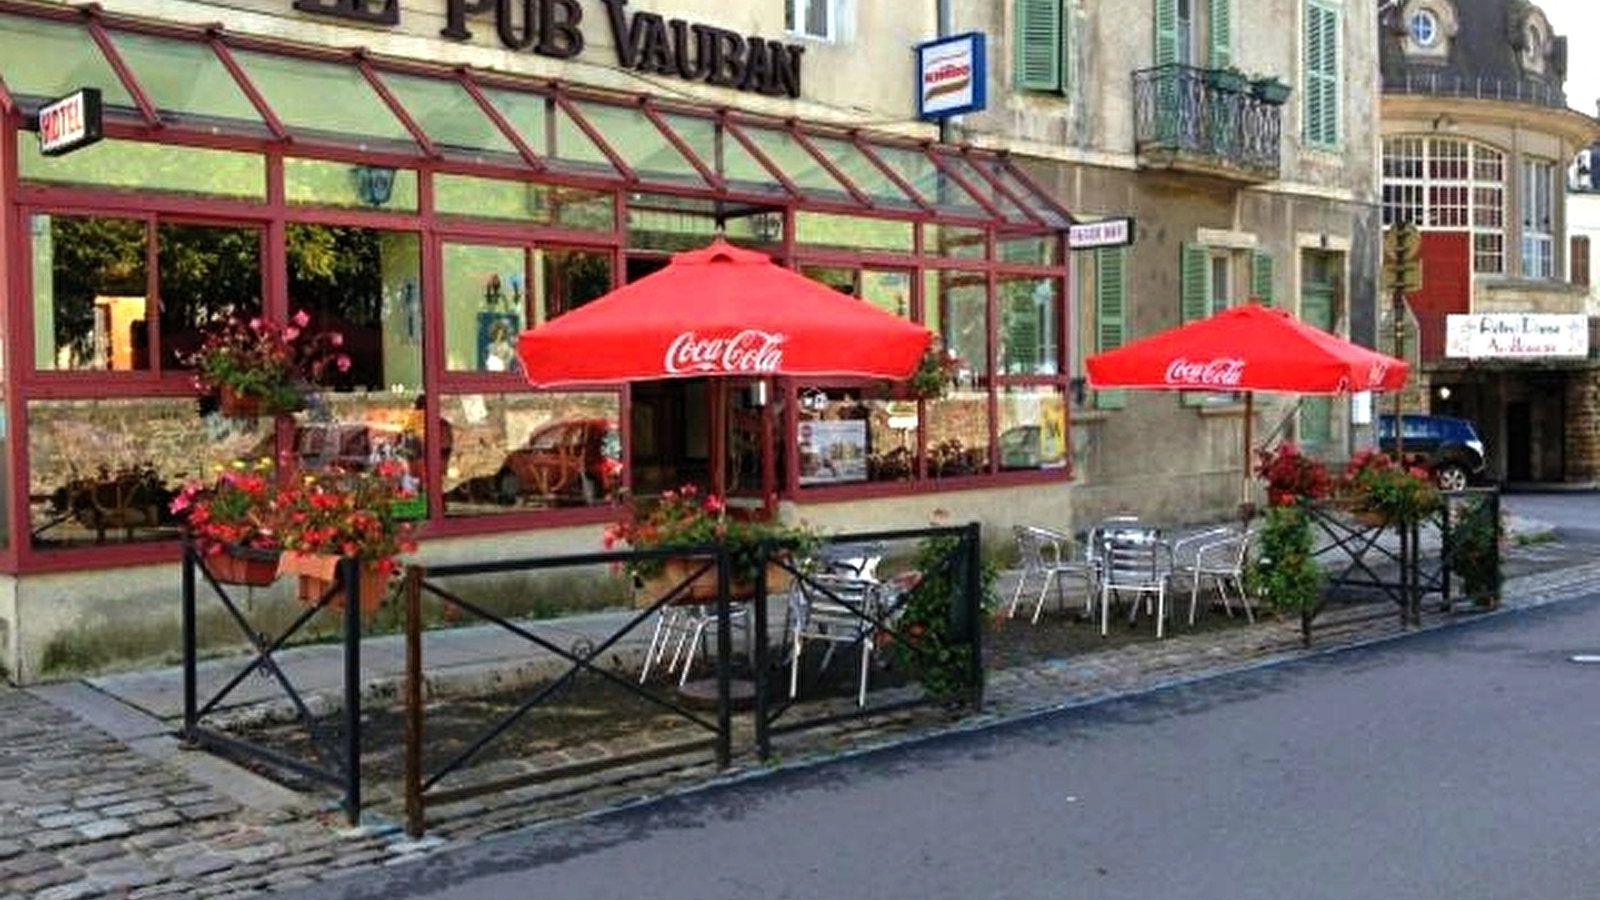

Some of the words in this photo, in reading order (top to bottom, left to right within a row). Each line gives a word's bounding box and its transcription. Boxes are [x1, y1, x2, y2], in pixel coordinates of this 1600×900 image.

[605, 0, 805, 98] VAUBAN
[665, 329, 788, 374] Coca-Cola
[1165, 357, 1246, 385] Coca-Cola
